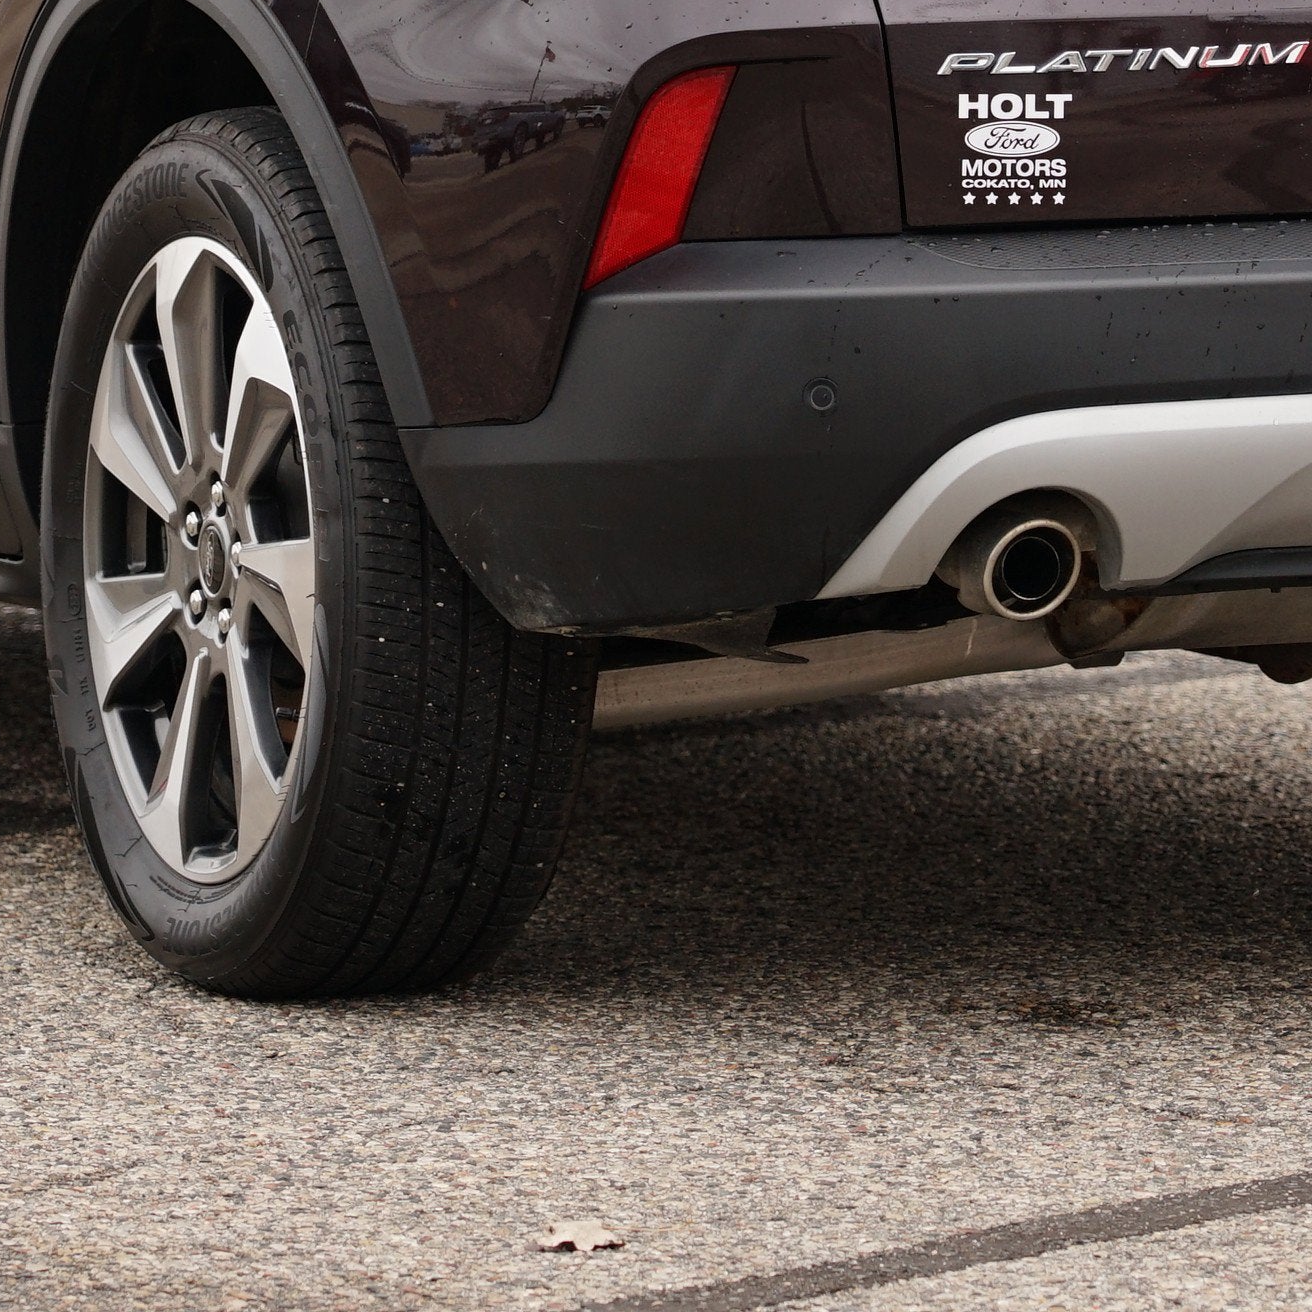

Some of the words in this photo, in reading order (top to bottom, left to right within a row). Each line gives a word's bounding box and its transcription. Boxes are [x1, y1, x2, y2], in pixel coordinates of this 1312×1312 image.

[936, 40, 1310, 76] PLATINUM
[958, 93, 1073, 119] HOLT
[984, 125, 1040, 151] Ford
[961, 158, 1067, 177] MOTORS
[961, 178, 1035, 190] COKATO,
[1038, 178, 1066, 188] MN
